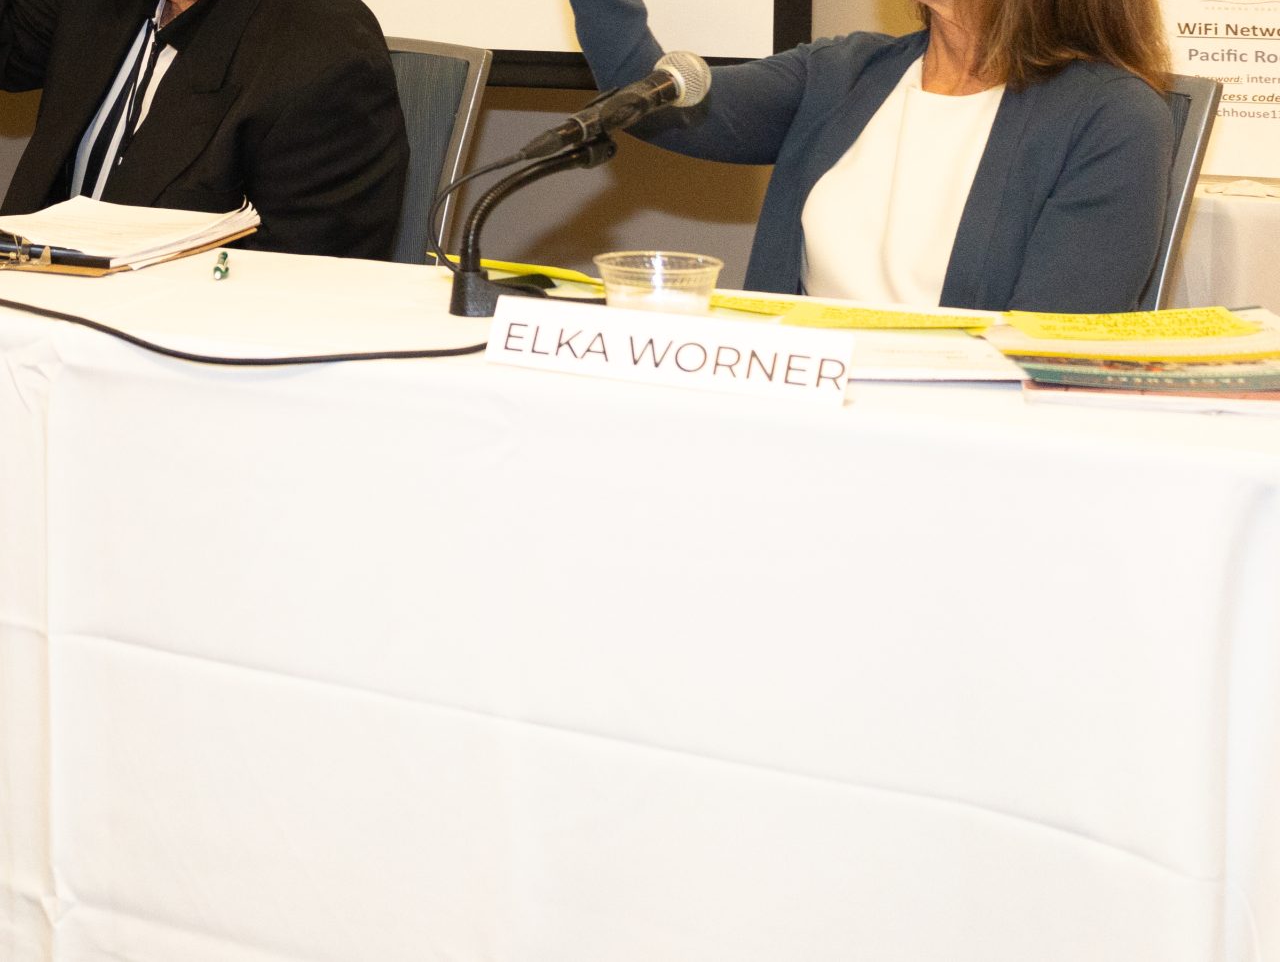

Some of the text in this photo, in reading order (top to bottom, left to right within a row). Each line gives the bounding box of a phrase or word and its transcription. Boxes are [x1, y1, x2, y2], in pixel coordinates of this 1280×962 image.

[1177, 22, 1218, 36] WiFi
[1188, 48, 1280, 64] Pacific Ro
[1222, 93, 1248, 102] cess
[503, 322, 846, 391] ELKA WORNER
